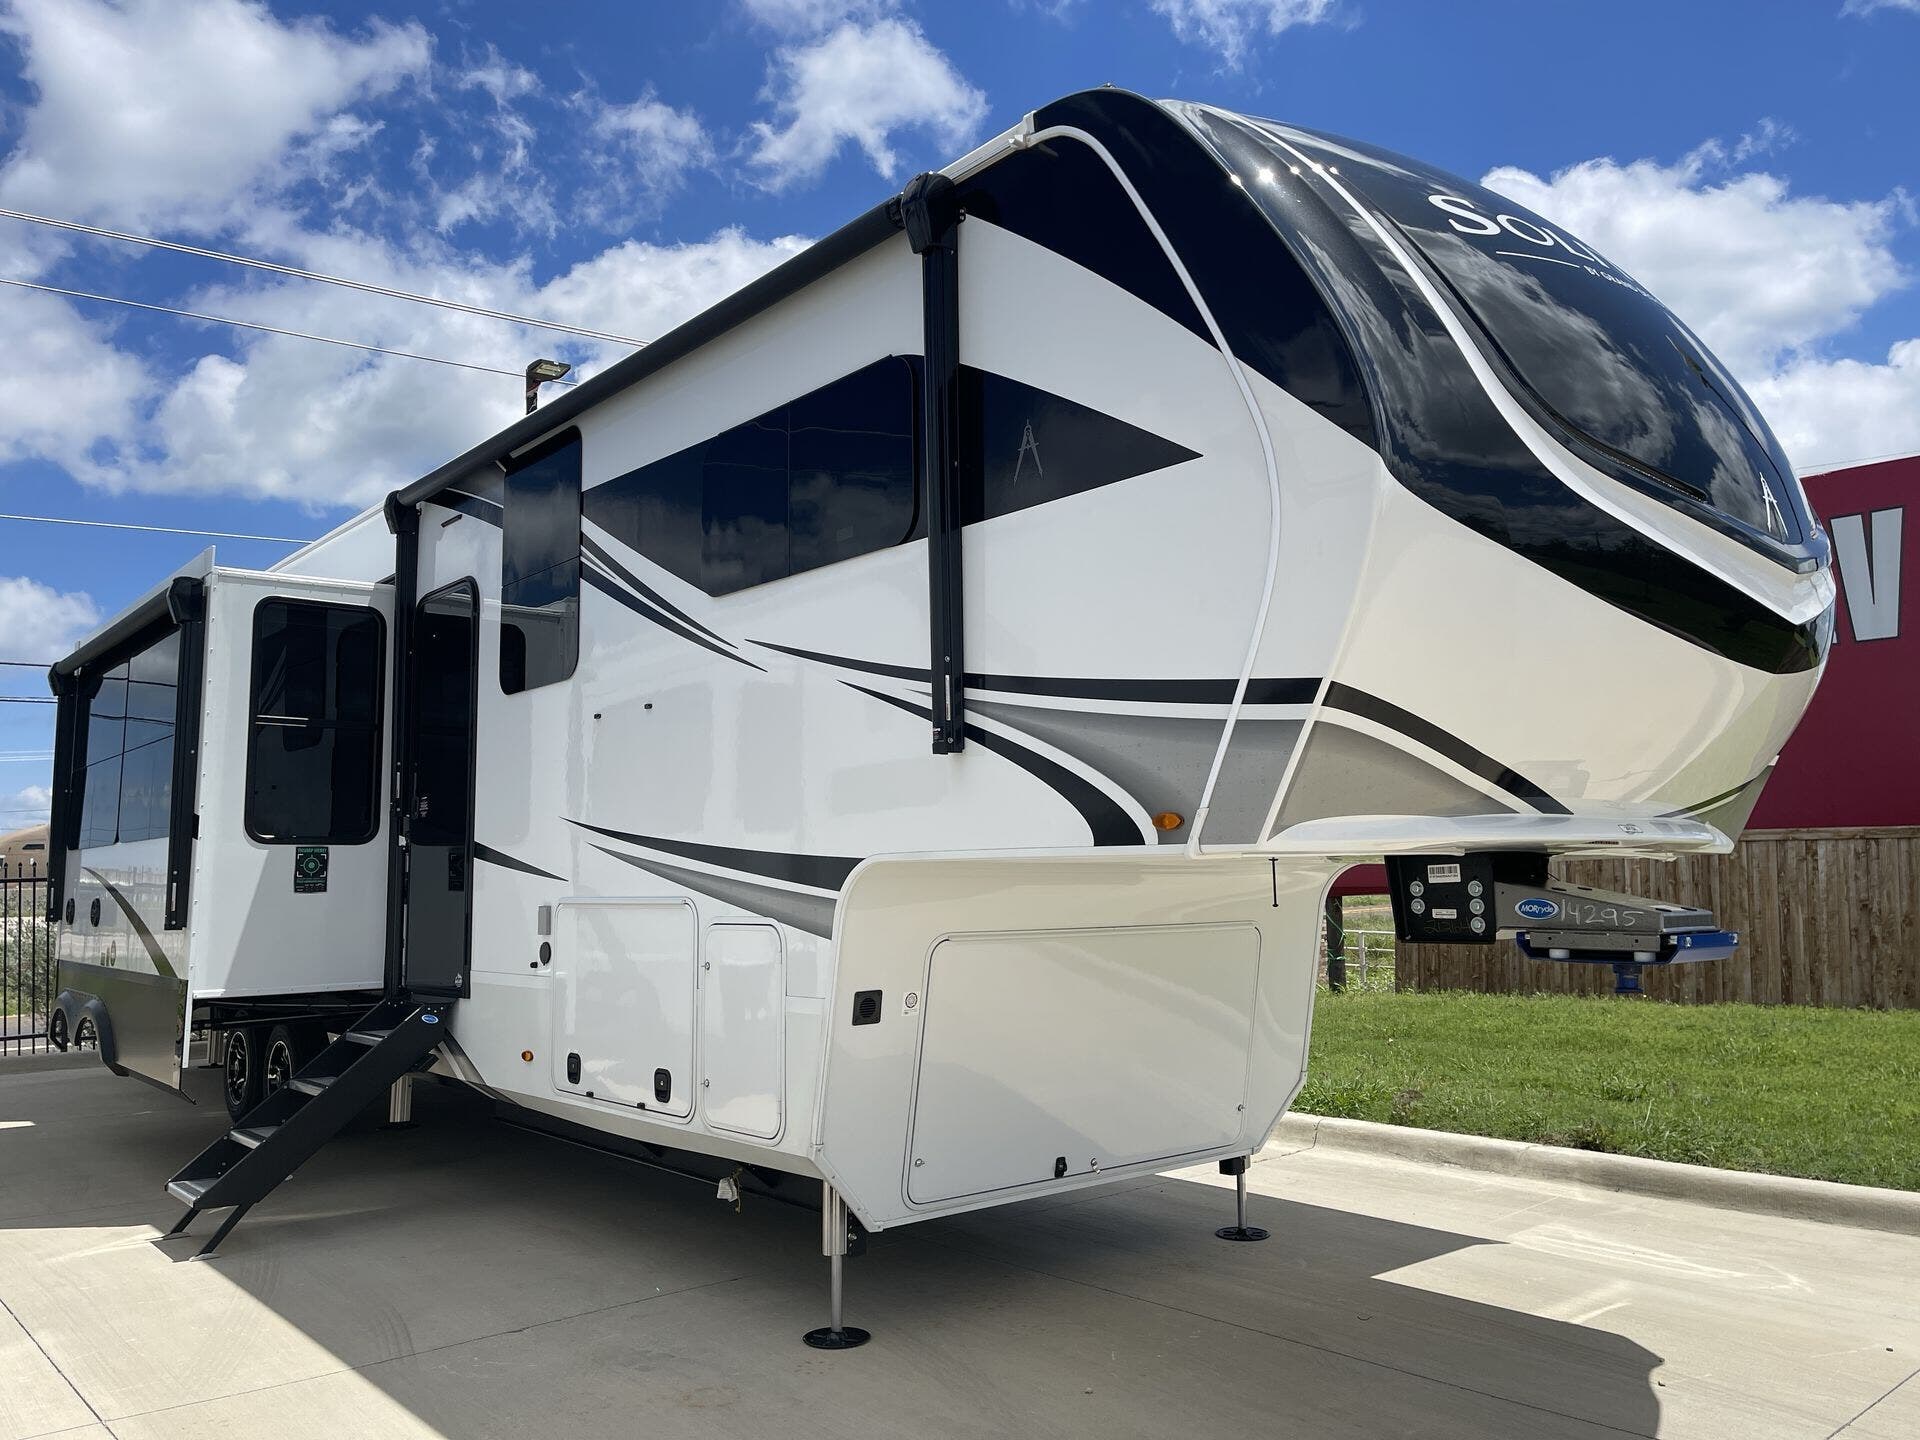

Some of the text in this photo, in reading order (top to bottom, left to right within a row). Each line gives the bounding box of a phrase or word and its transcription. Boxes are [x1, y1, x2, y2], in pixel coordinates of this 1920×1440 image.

[1428, 194, 1634, 282] SOLI
[1831, 507, 1903, 643] V
[1520, 904, 1554, 914] MORryde
[1561, 899, 1645, 926] 14295
